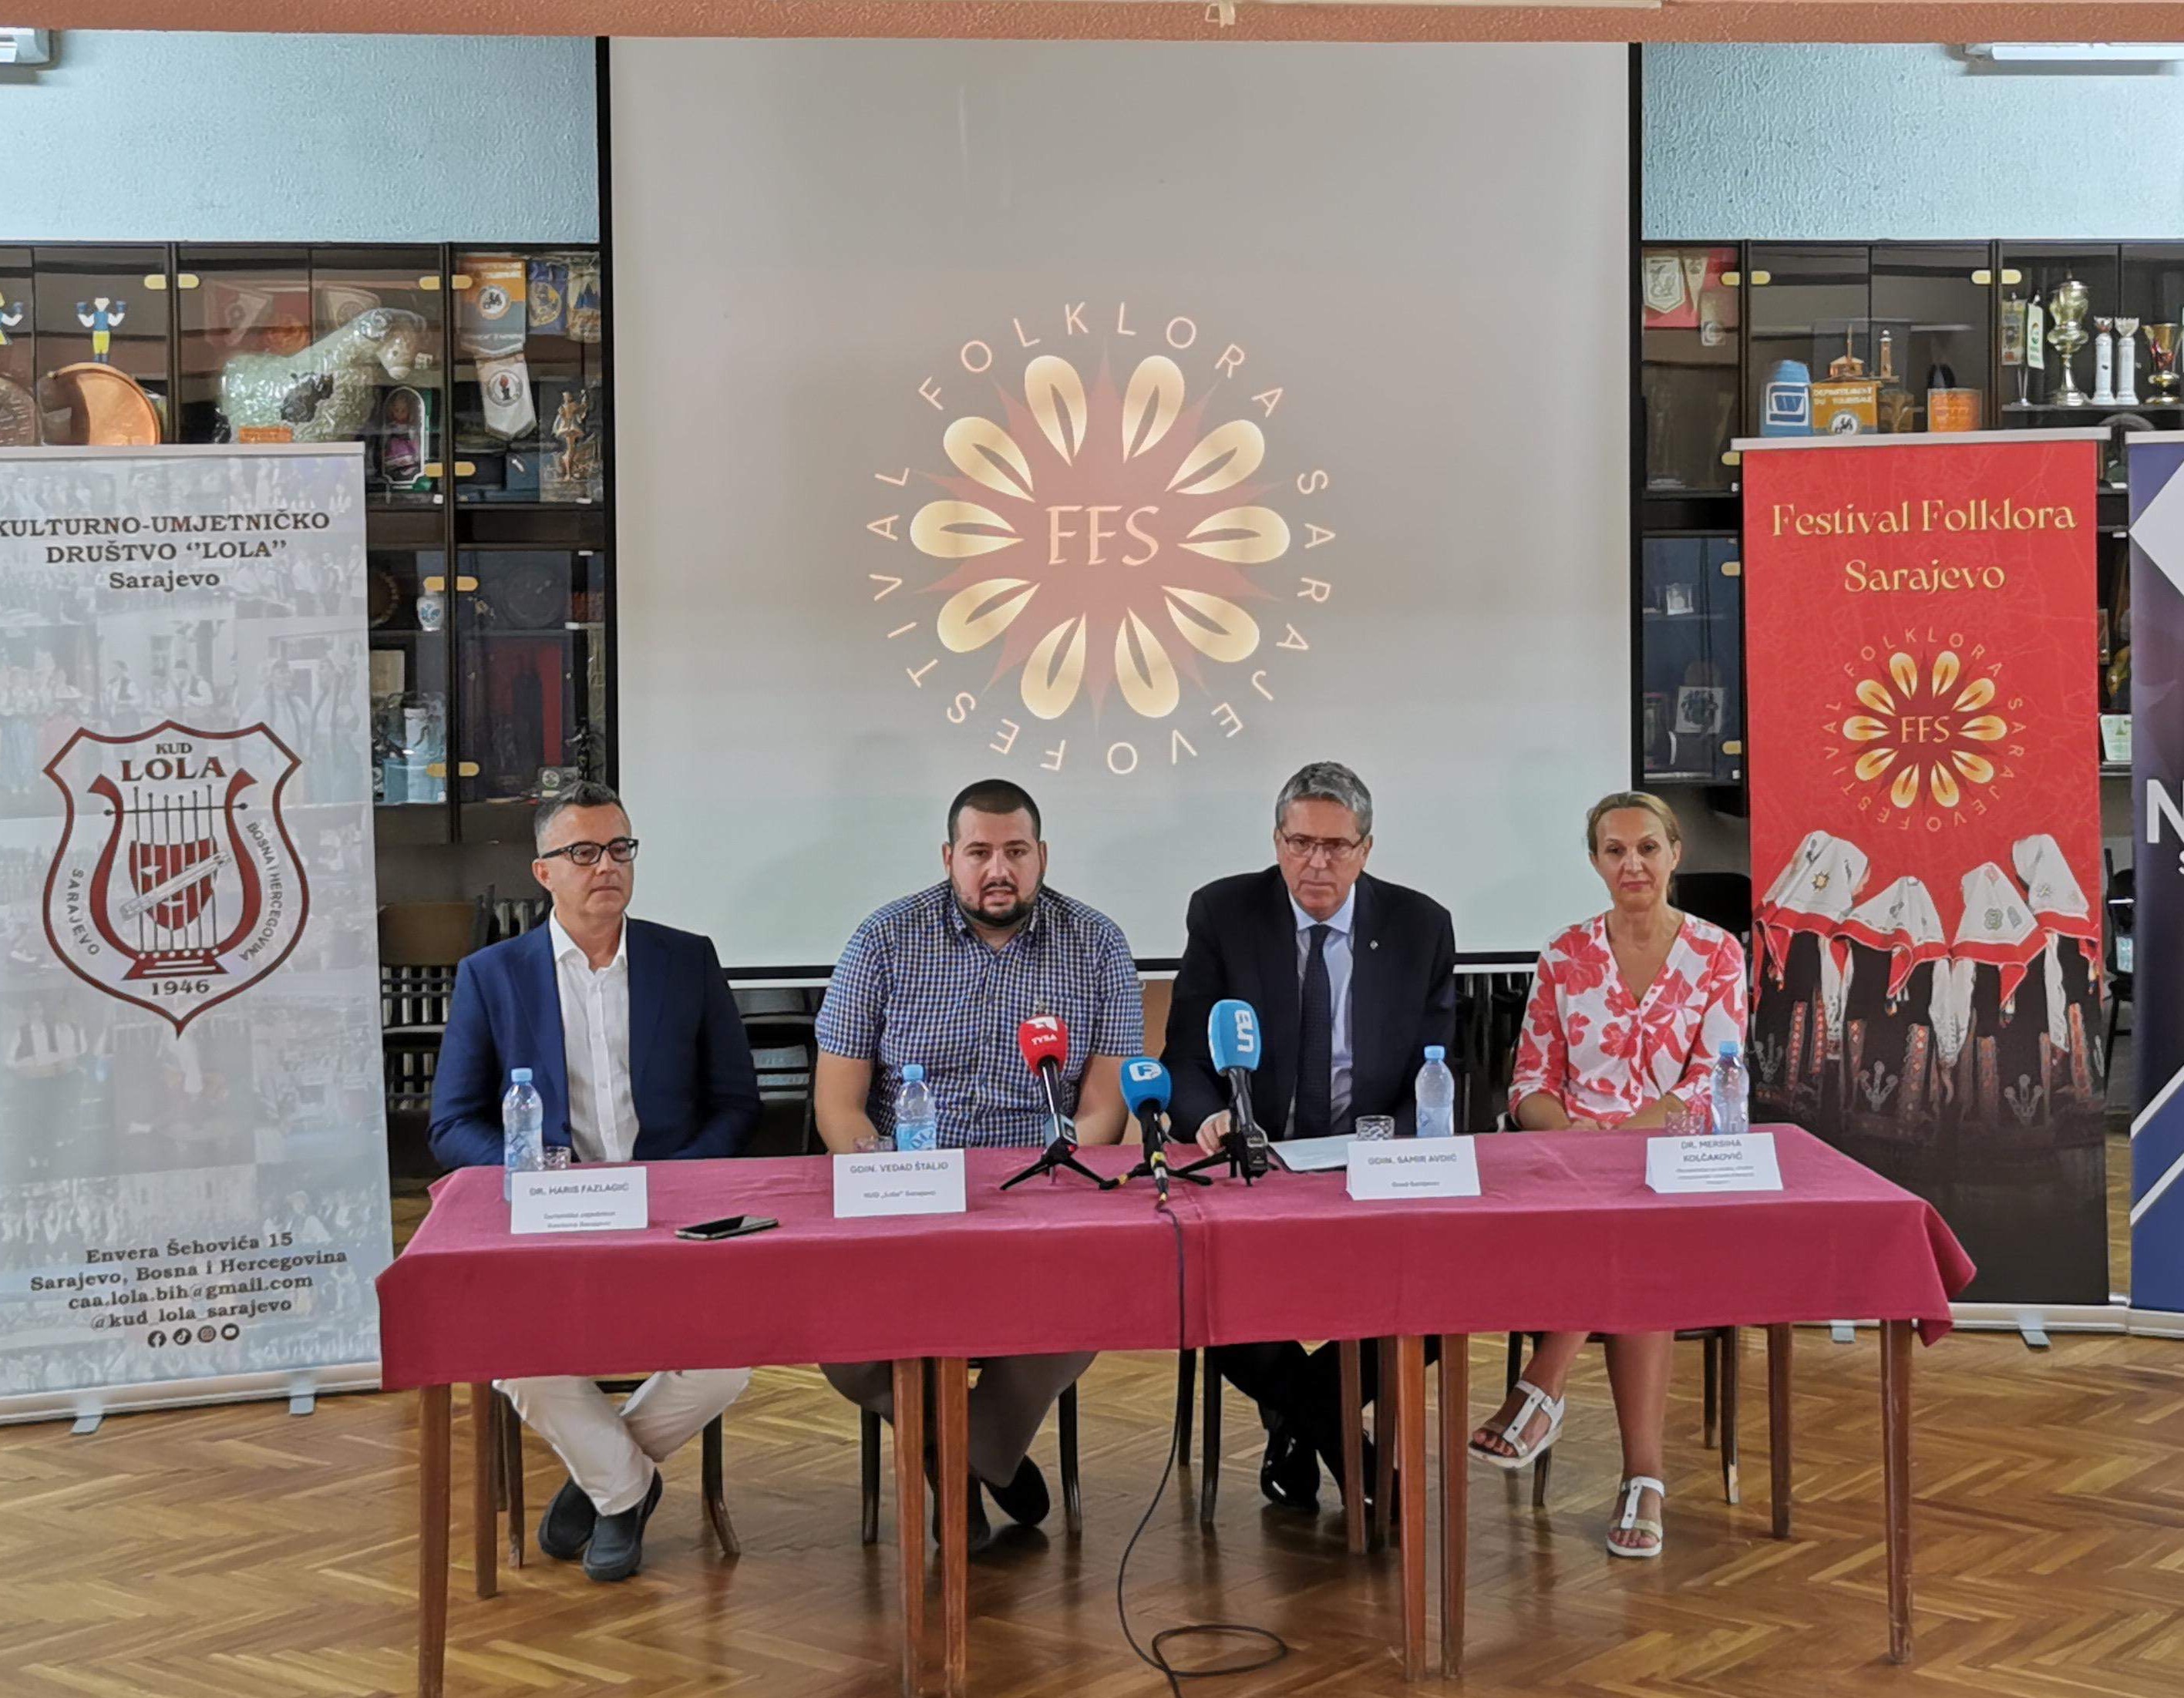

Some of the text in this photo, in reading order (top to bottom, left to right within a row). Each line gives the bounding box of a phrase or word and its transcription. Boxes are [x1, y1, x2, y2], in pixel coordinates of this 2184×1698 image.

[918, 301, 1284, 418] FOLKLORA
[0, 509, 331, 537] KULTURNO-UMJETNIČKO
[1772, 497, 2078, 536] Festival Folklora
[46, 541, 177, 563] DRUŠTVO
[1045, 505, 1159, 567] FFS
[109, 571, 220, 593] Sarajevo
[1844, 559, 2006, 595] Sarajevo
[866, 466, 1065, 771] FESTIVAL
[1106, 469, 1336, 774] SARAJEVO
[1900, 715, 1950, 744] FFS
[156, 742, 193, 755] KUD
[121, 756, 227, 782] LOLA
[66, 868, 100, 956] SARAJEVO
[151, 980, 210, 995] 1946
[880, 1162, 913, 1173] VEDAD
[86, 1232, 293, 1265] Envera Šehovića 15
[30, 1249, 348, 1293] Sarajevo, Bosna i Hercegovina
[68, 1274, 314, 1311] caa.lola.bih@gmail.com
[89, 1297, 293, 1332] @kud_lola_sarajevo
